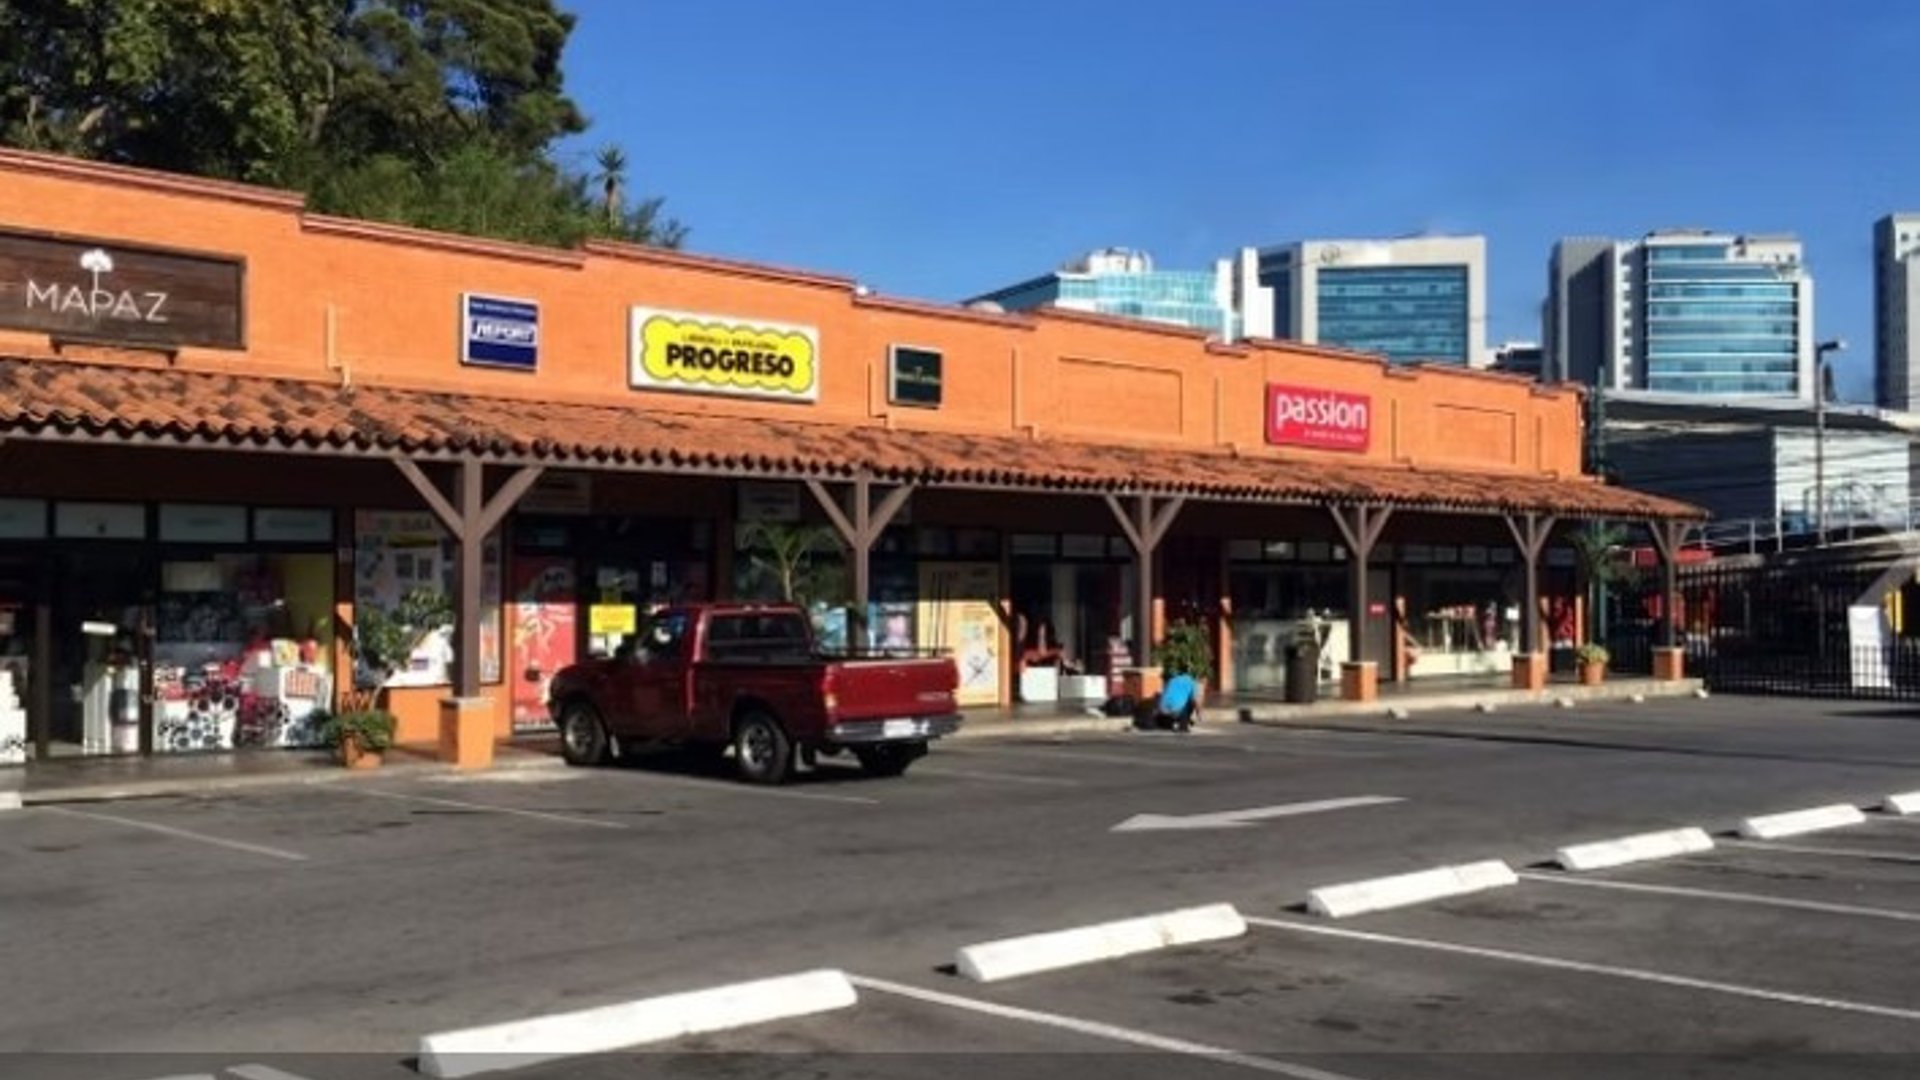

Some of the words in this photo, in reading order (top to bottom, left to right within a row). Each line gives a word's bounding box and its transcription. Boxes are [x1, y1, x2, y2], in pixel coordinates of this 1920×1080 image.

[26, 278, 169, 323] MAPAZ
[666, 342, 795, 378] PROGRESO
[1276, 391, 1368, 431] passion
